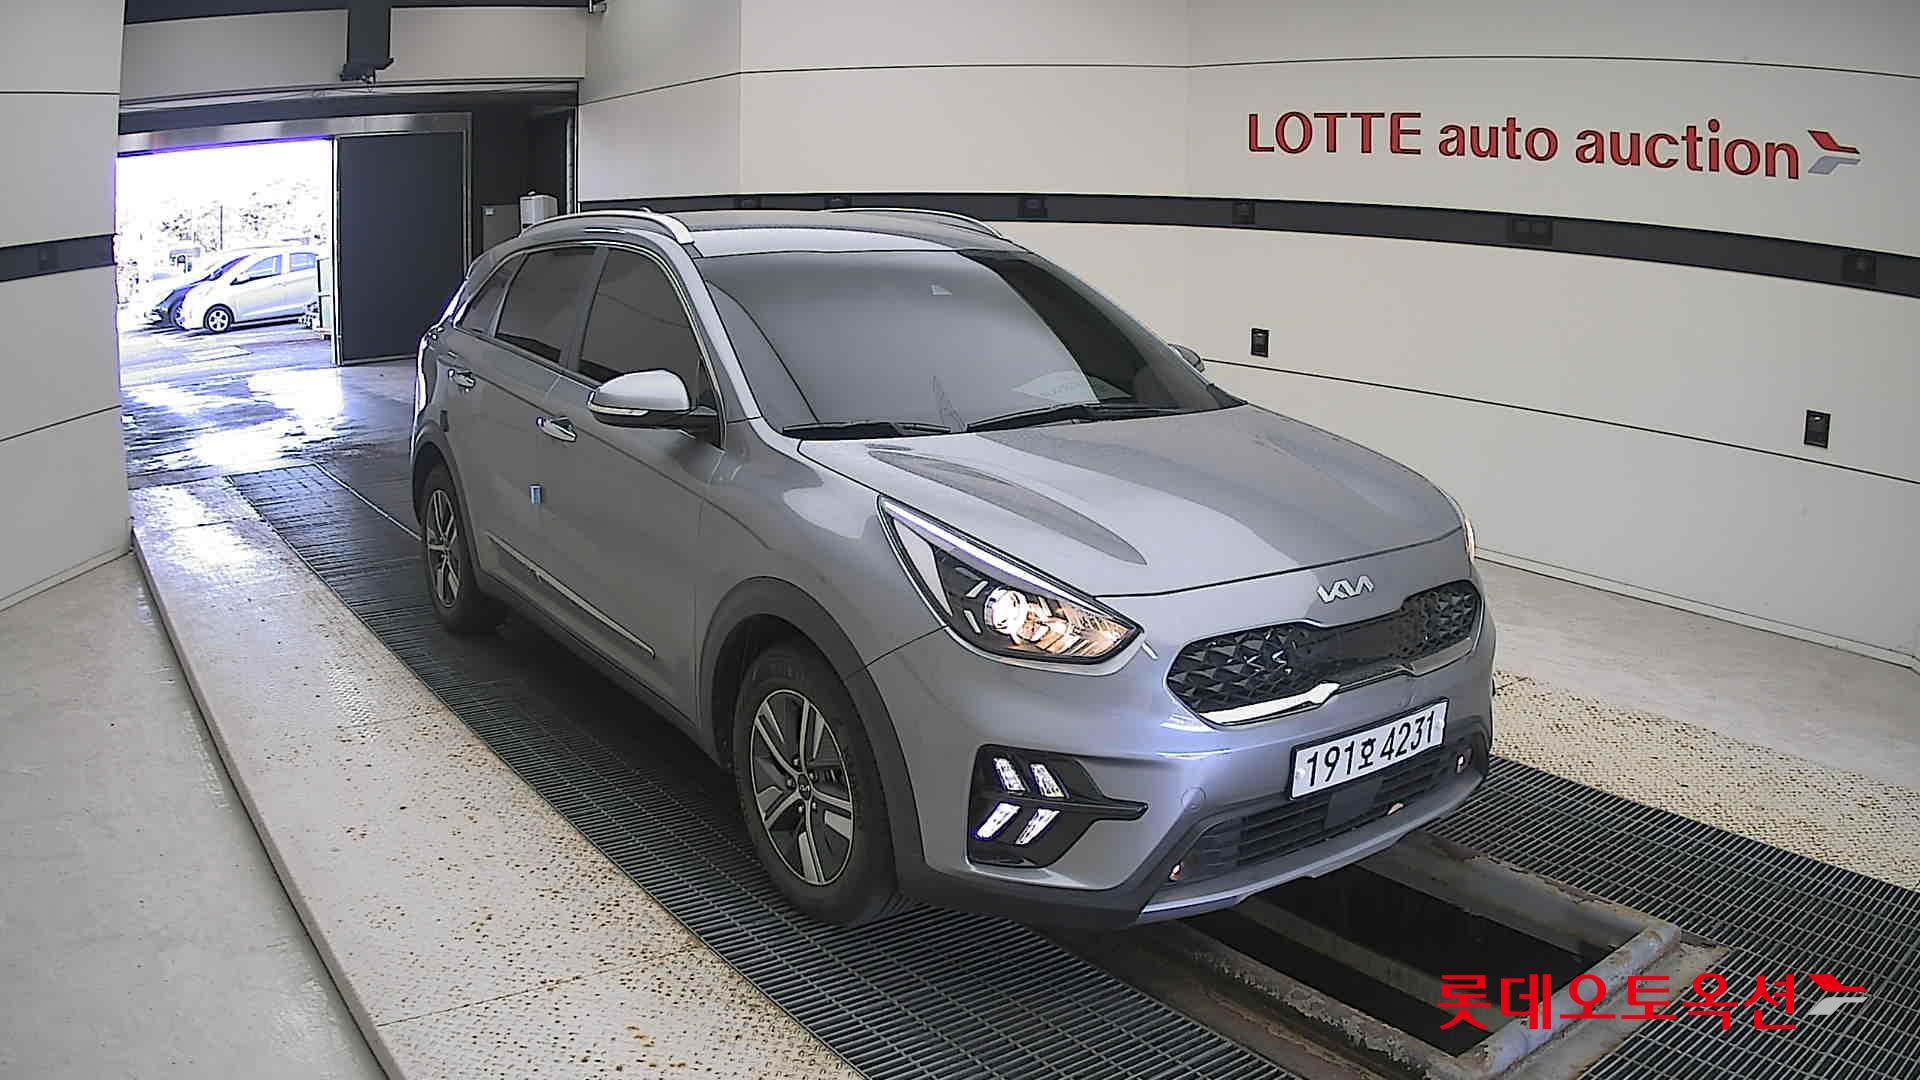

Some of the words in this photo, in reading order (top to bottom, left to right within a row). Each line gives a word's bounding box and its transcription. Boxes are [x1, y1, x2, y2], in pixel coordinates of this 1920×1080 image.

[1248, 111, 1422, 155] LOTTE
[1438, 117, 1559, 161] auto
[1575, 119, 1800, 180] auction
[1317, 575, 1375, 603] KIA
